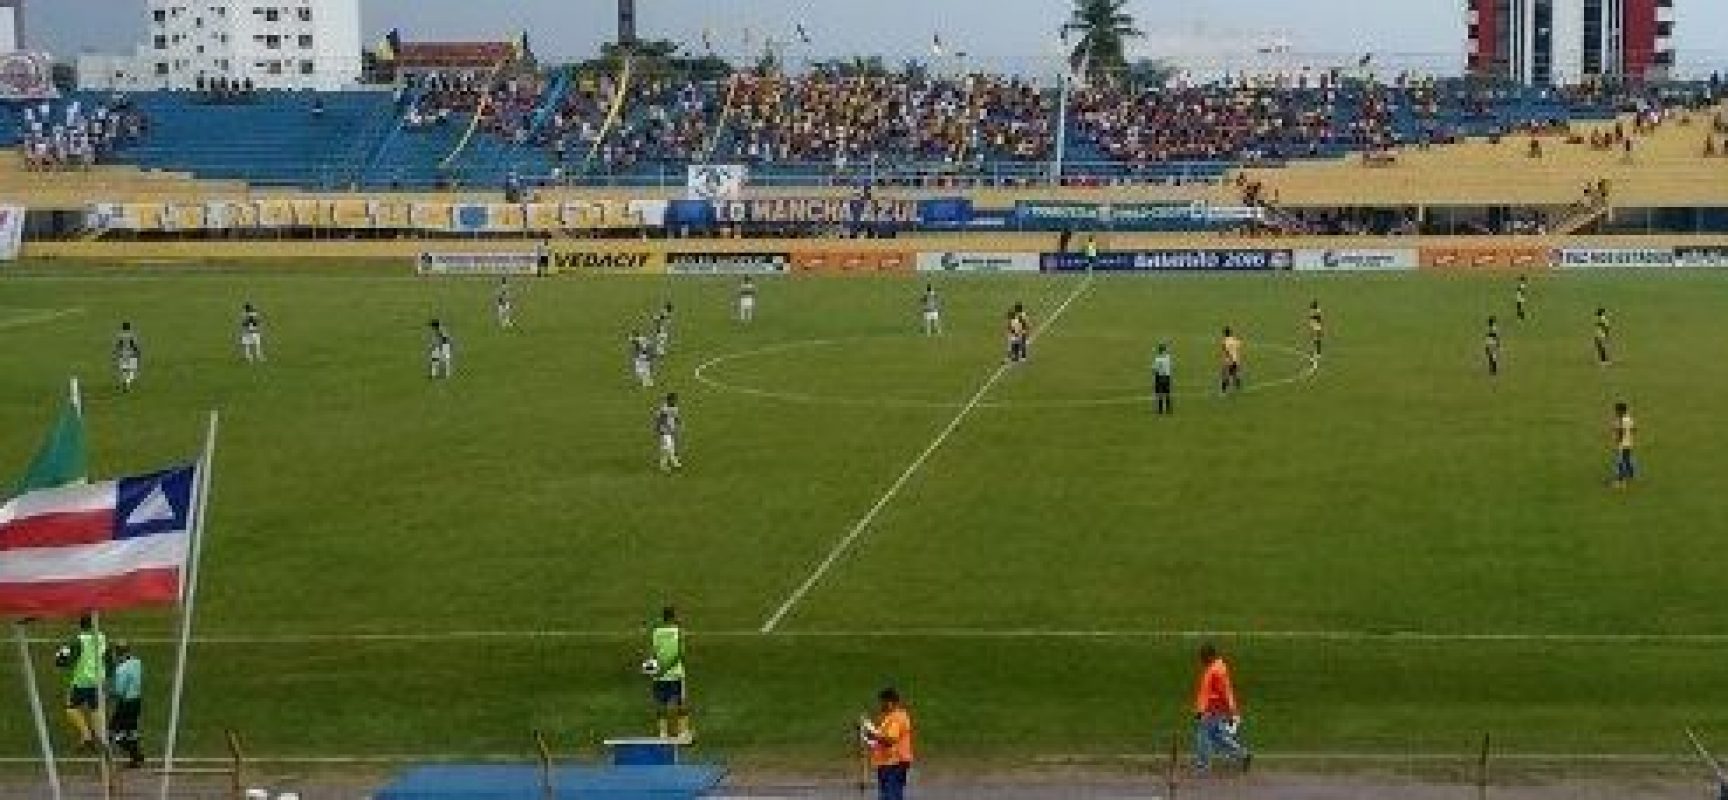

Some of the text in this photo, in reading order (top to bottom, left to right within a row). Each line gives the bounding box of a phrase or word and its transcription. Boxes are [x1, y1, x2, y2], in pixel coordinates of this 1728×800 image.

[752, 199, 854, 222] MANCHA
[859, 199, 924, 222] AZUL
[553, 252, 652, 267] VEDACIT
